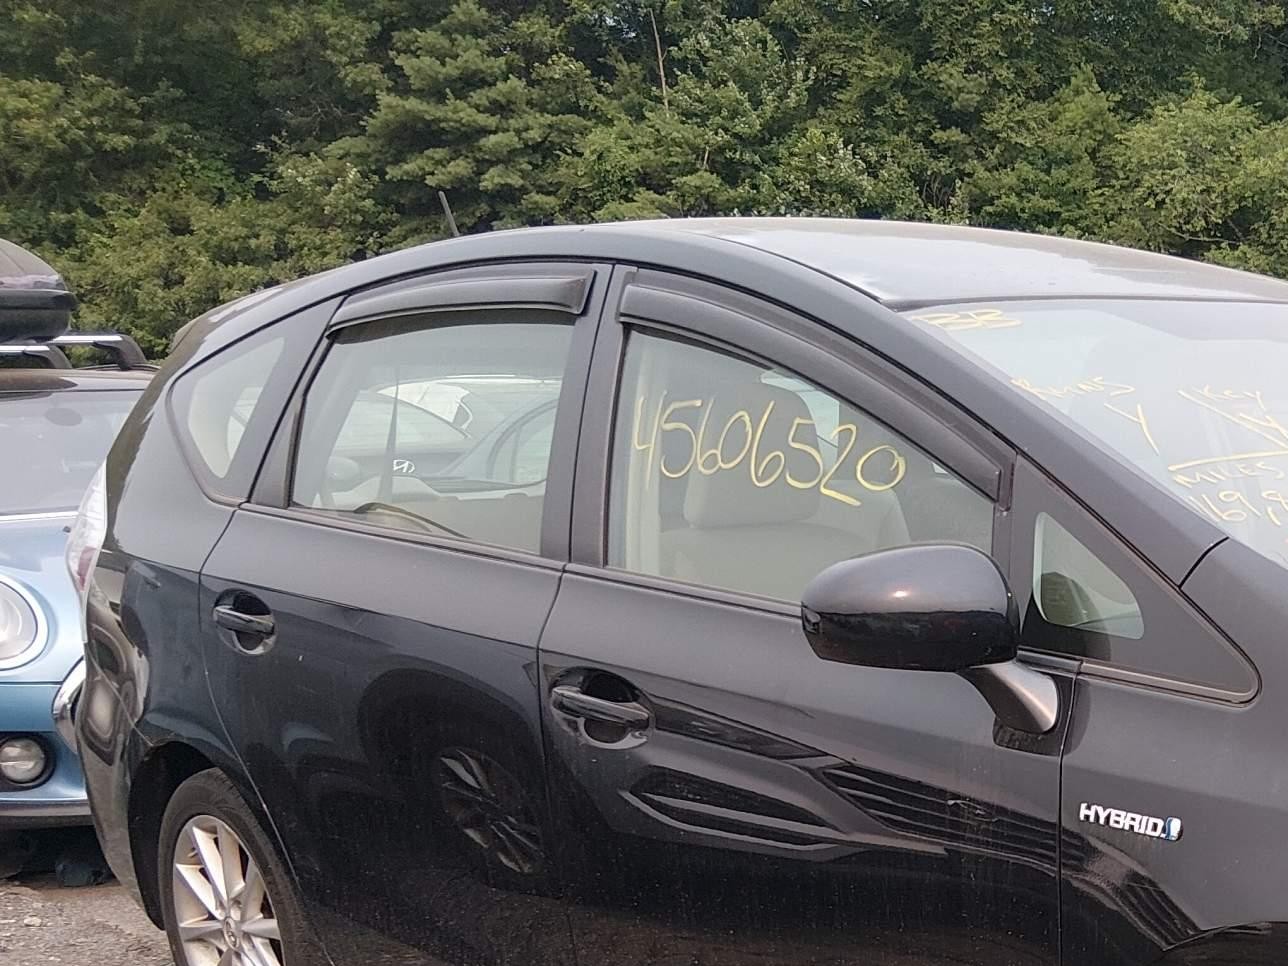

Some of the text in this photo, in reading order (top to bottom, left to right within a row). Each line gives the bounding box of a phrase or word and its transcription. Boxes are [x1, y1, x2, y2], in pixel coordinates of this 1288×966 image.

[631, 390, 907, 507] 45606520
[1173, 461, 1286, 488] MILES
[1079, 802, 1165, 838] HYBRID
